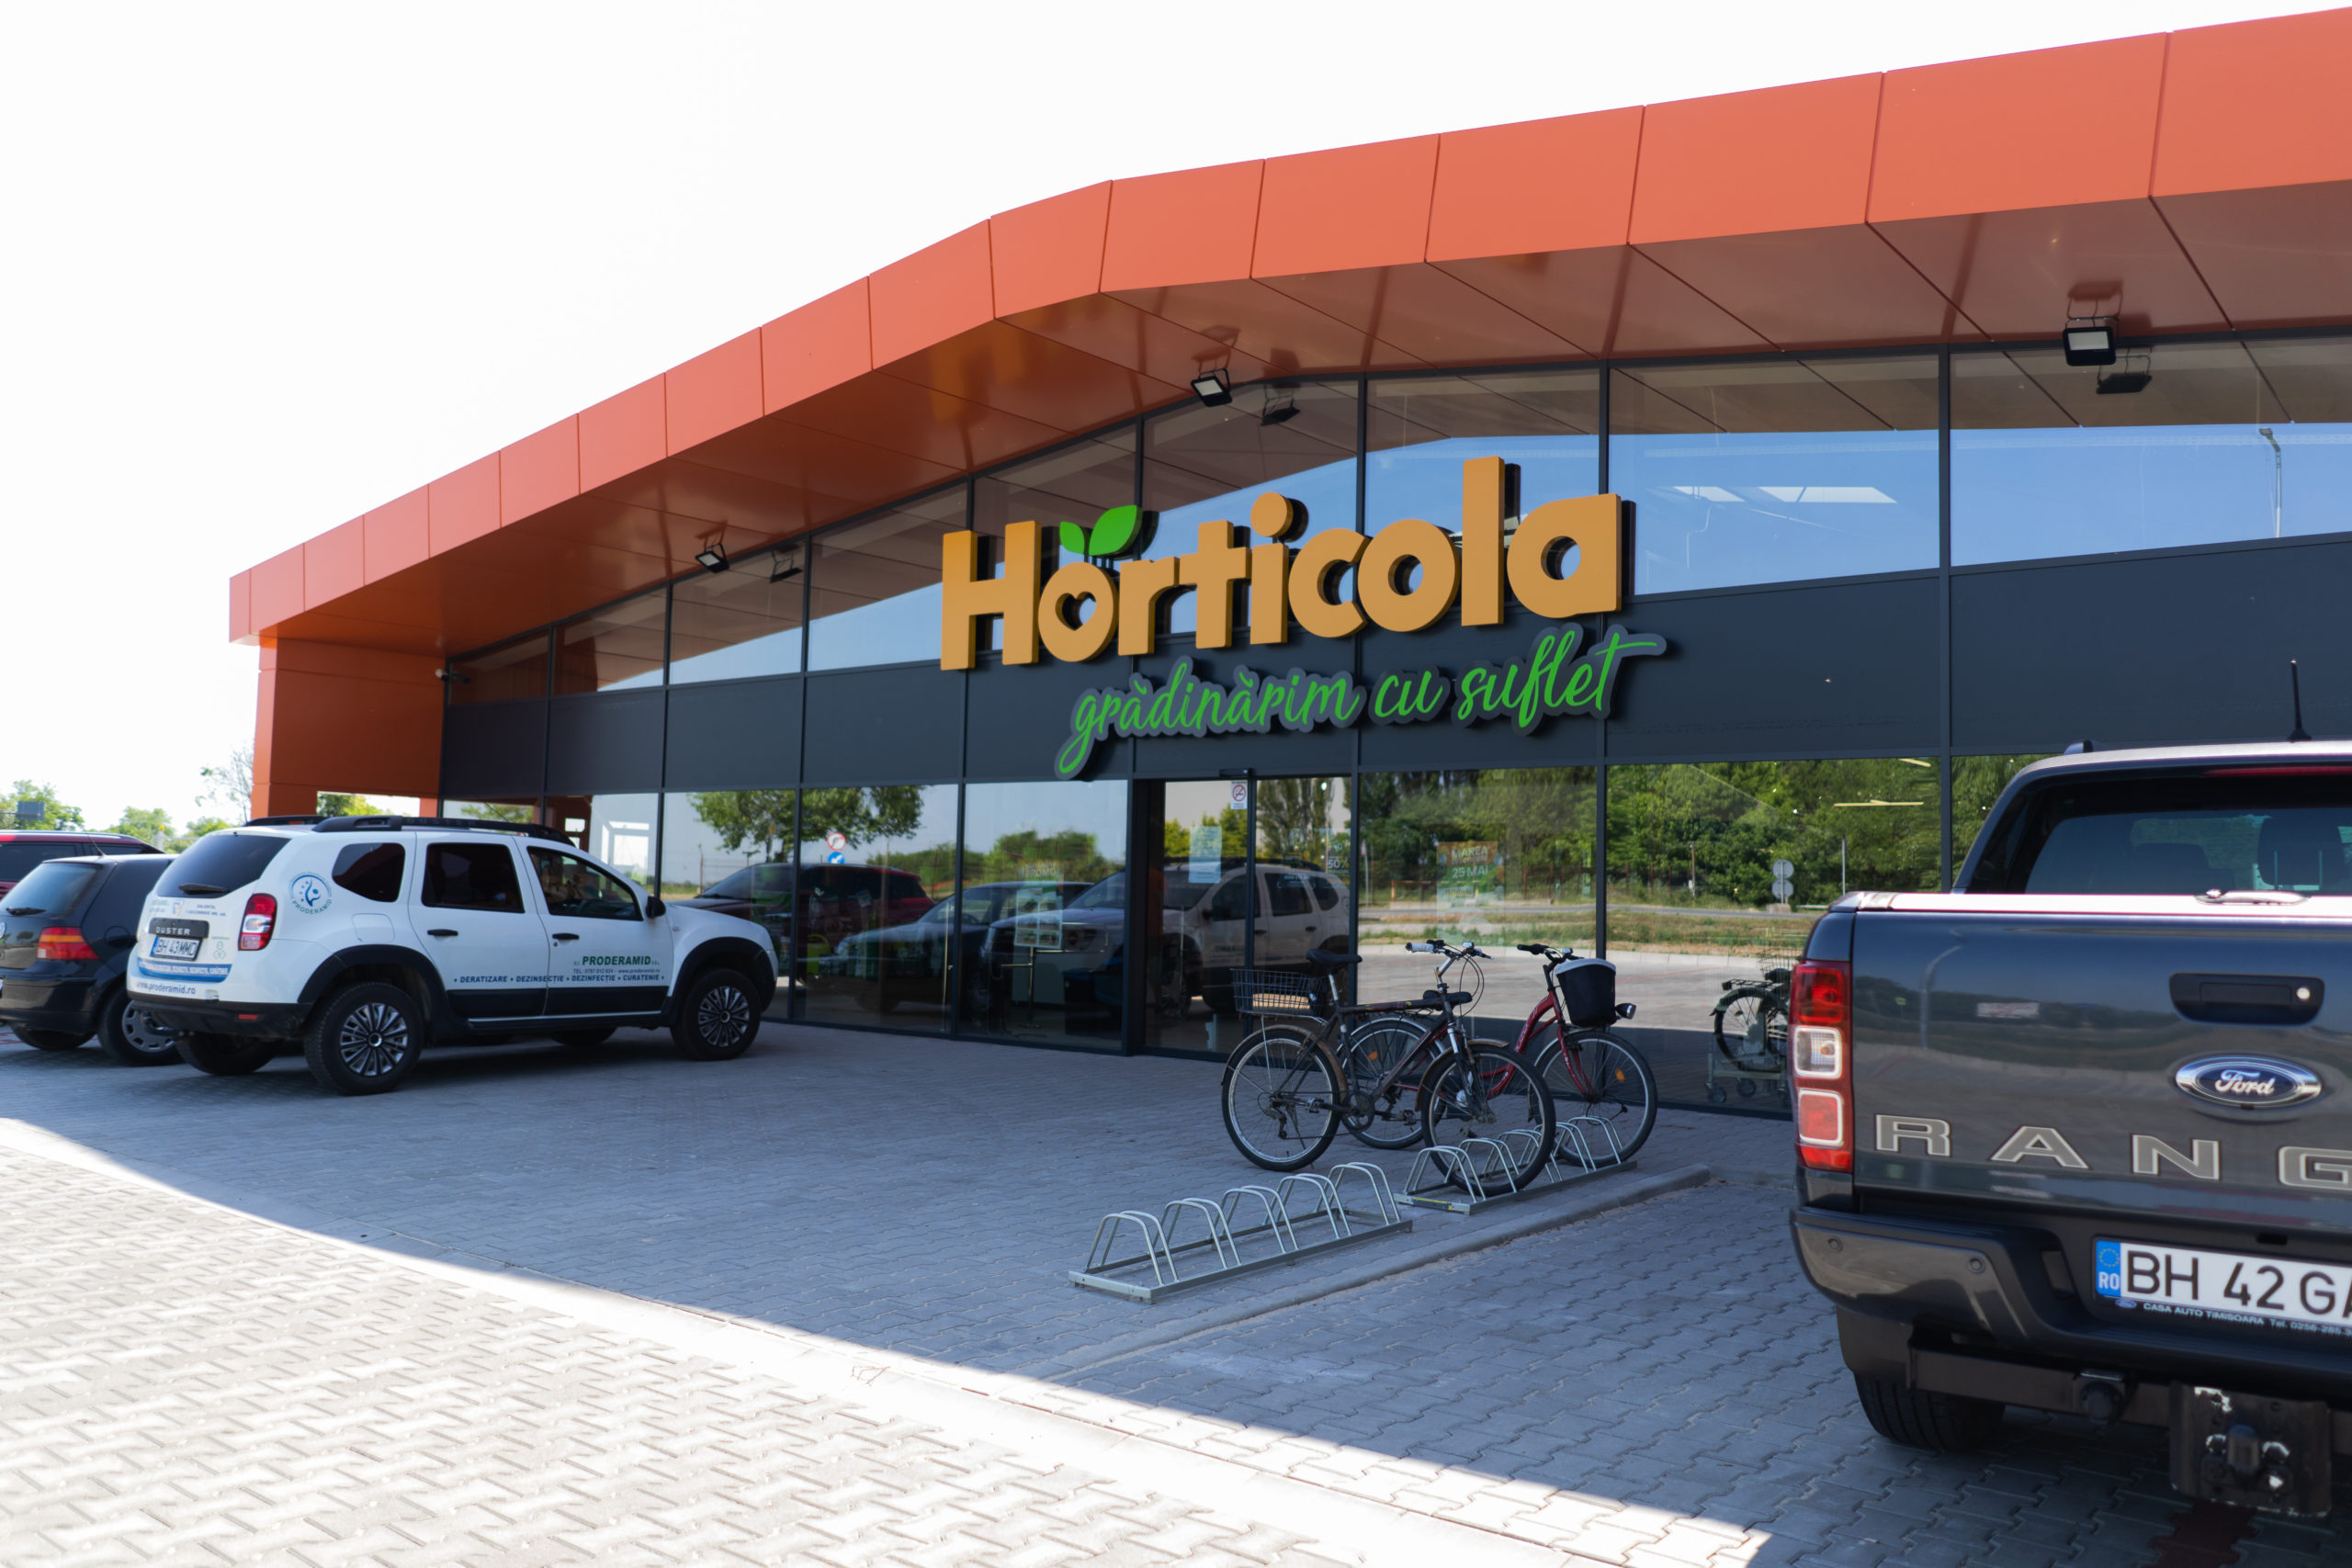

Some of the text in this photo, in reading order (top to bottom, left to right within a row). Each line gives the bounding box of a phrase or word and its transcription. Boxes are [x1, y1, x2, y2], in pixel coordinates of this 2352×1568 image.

[941, 456, 1622, 671] Horticola
[1374, 671, 1443, 717] cu
[1457, 629, 1657, 728] suflet
[1452, 845, 1488, 858] MAREA
[1453, 865, 1488, 879] 25 MAI
[291, 898, 333, 915] PRODERAMID
[156, 926, 191, 935] DUSTER
[582, 956, 651, 965] PRODERAMID
[2214, 1068, 2276, 1096] Ford
[2098, 1271, 2120, 1291] RO
[2128, 1250, 2199, 1301] BH
[2223, 1262, 2285, 1311] 42
[2143, 1303, 2172, 1314] CASA
[2175, 1306, 2204, 1318] AUTO
[2206, 1311, 2265, 1325] TIMISOARA
